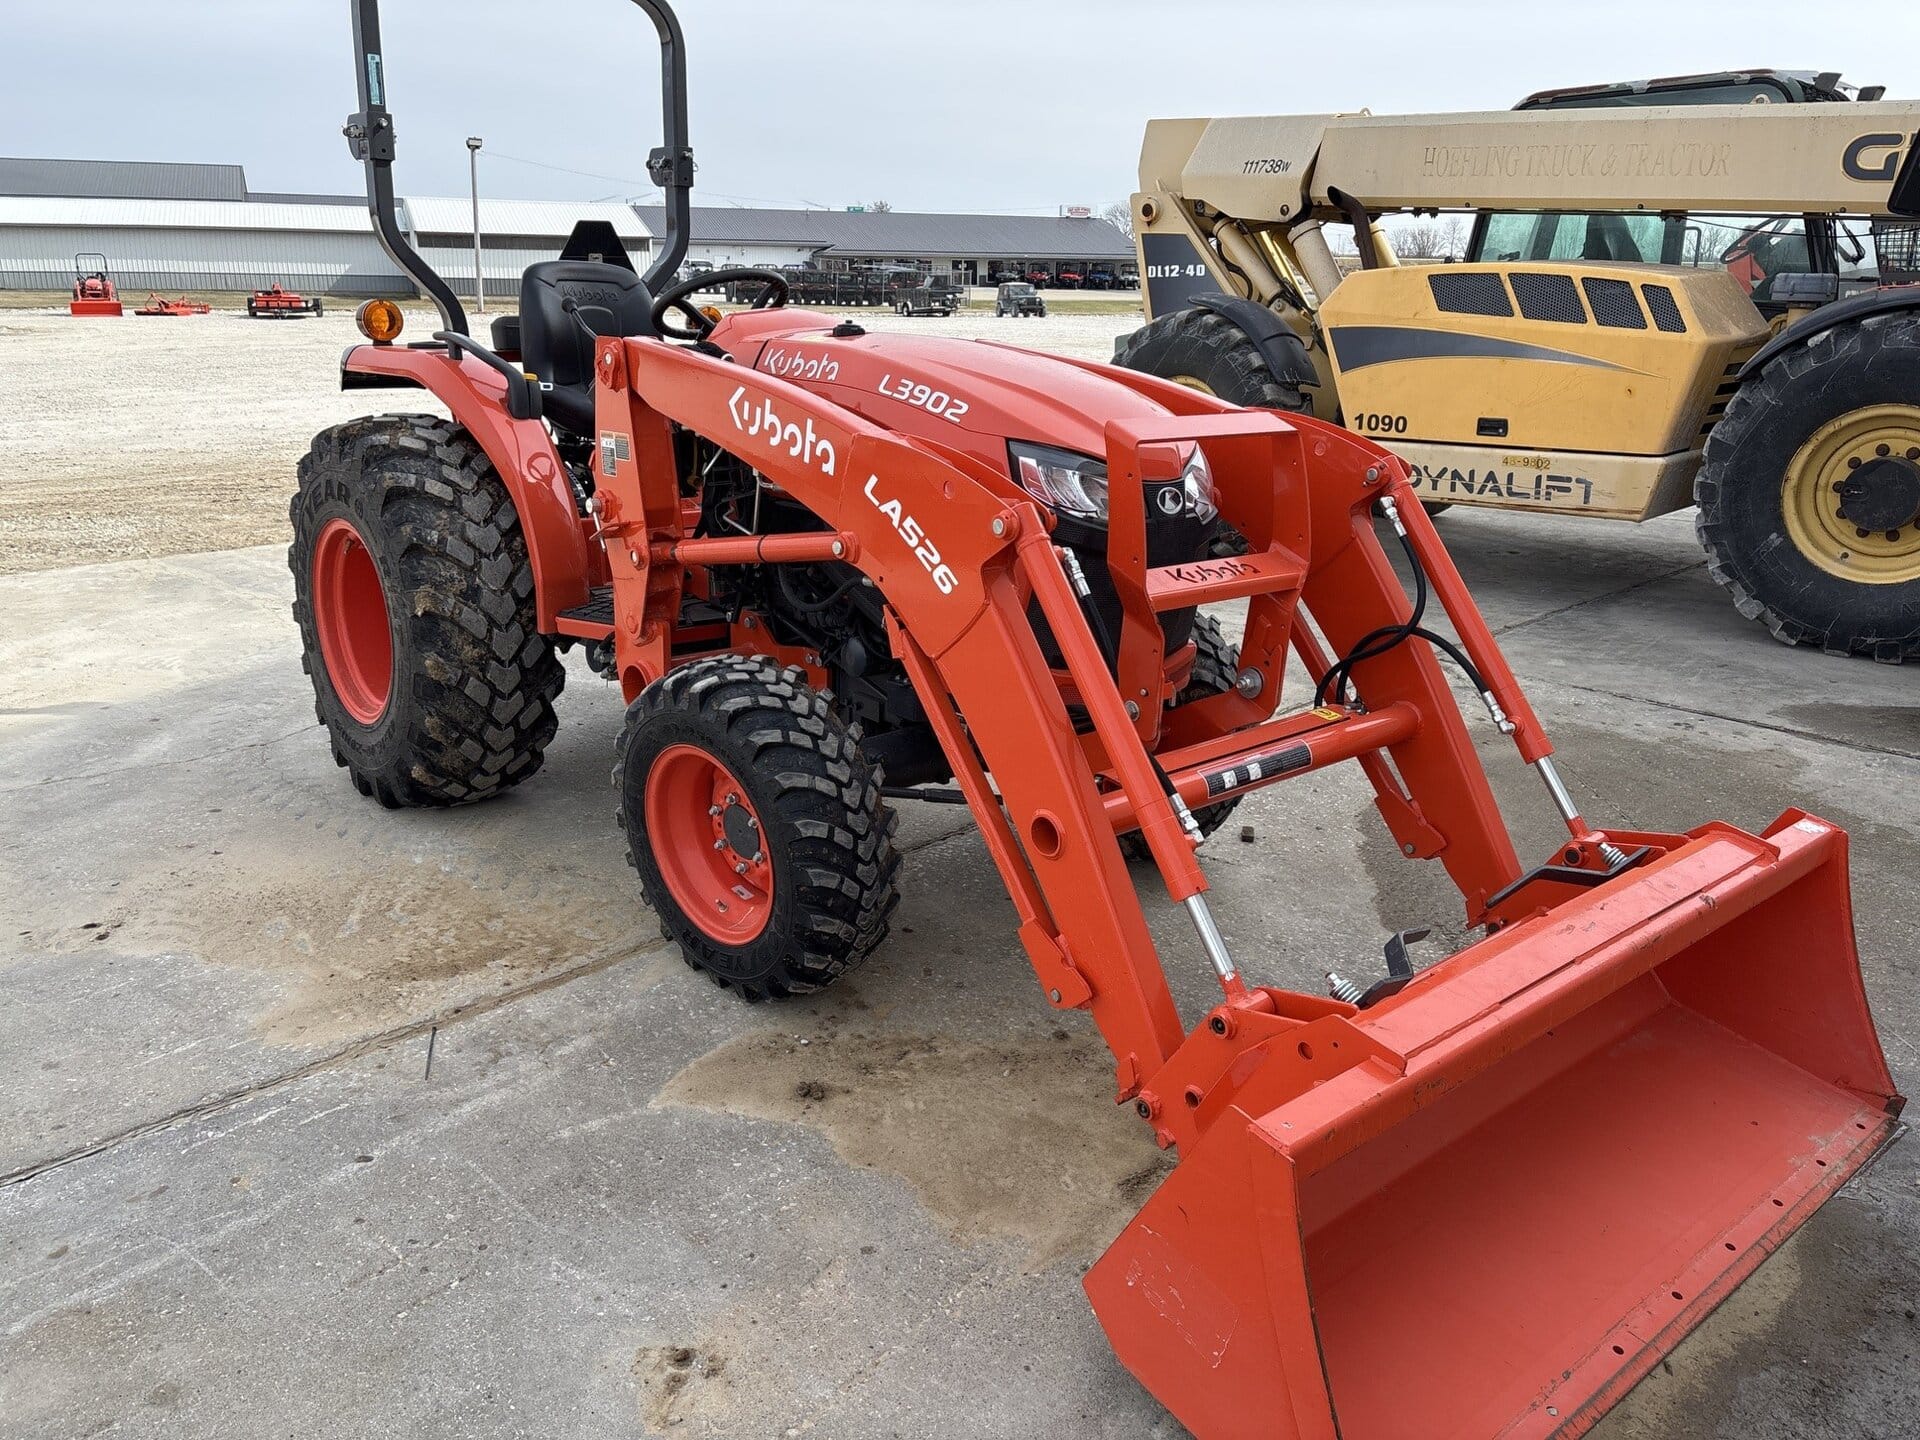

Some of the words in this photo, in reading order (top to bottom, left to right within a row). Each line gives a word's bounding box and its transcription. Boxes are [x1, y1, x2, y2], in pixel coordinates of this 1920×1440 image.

[1524, 144, 1597, 177] TRUCK
[1600, 144, 1616, 177] &
[1623, 143, 1733, 177] TRACTOR
[764, 348, 840, 382] Kubota
[878, 374, 969, 424] L3902
[728, 386, 836, 476] Kubota
[1354, 413, 1408, 433] 1090
[863, 474, 959, 595] LA526
[1164, 561, 1261, 584] Kubota
